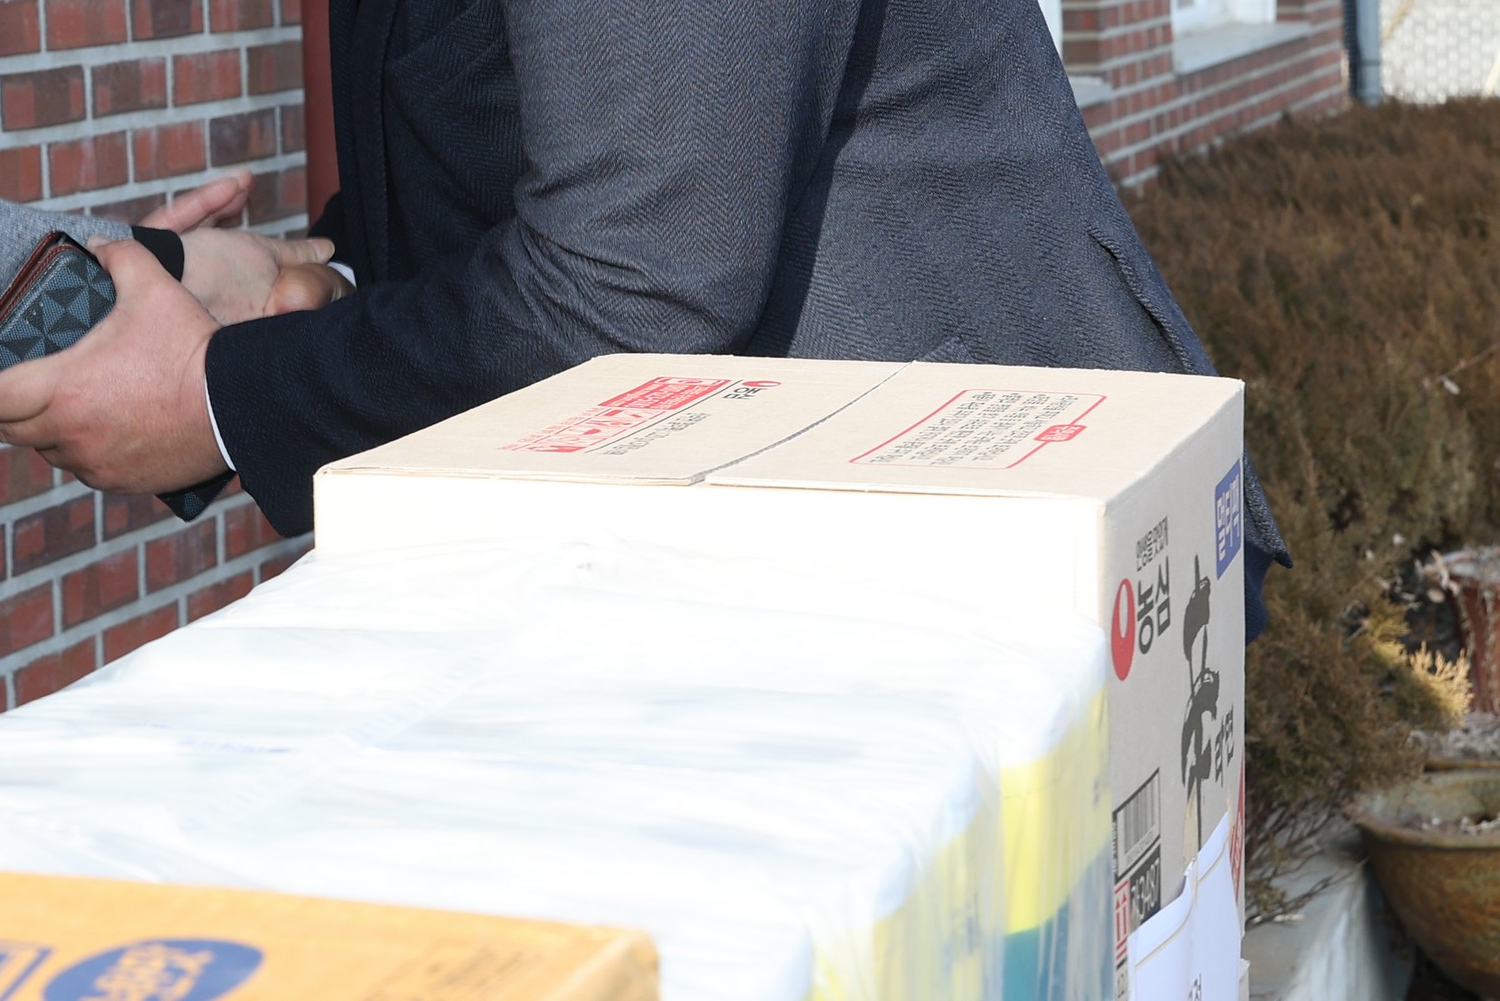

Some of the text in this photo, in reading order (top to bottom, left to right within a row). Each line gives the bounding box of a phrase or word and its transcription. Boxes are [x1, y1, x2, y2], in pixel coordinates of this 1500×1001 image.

[1216, 473, 1241, 563] 멀티팩
[1137, 555, 1171, 655] 농심
[1215, 705, 1234, 786] 라면
